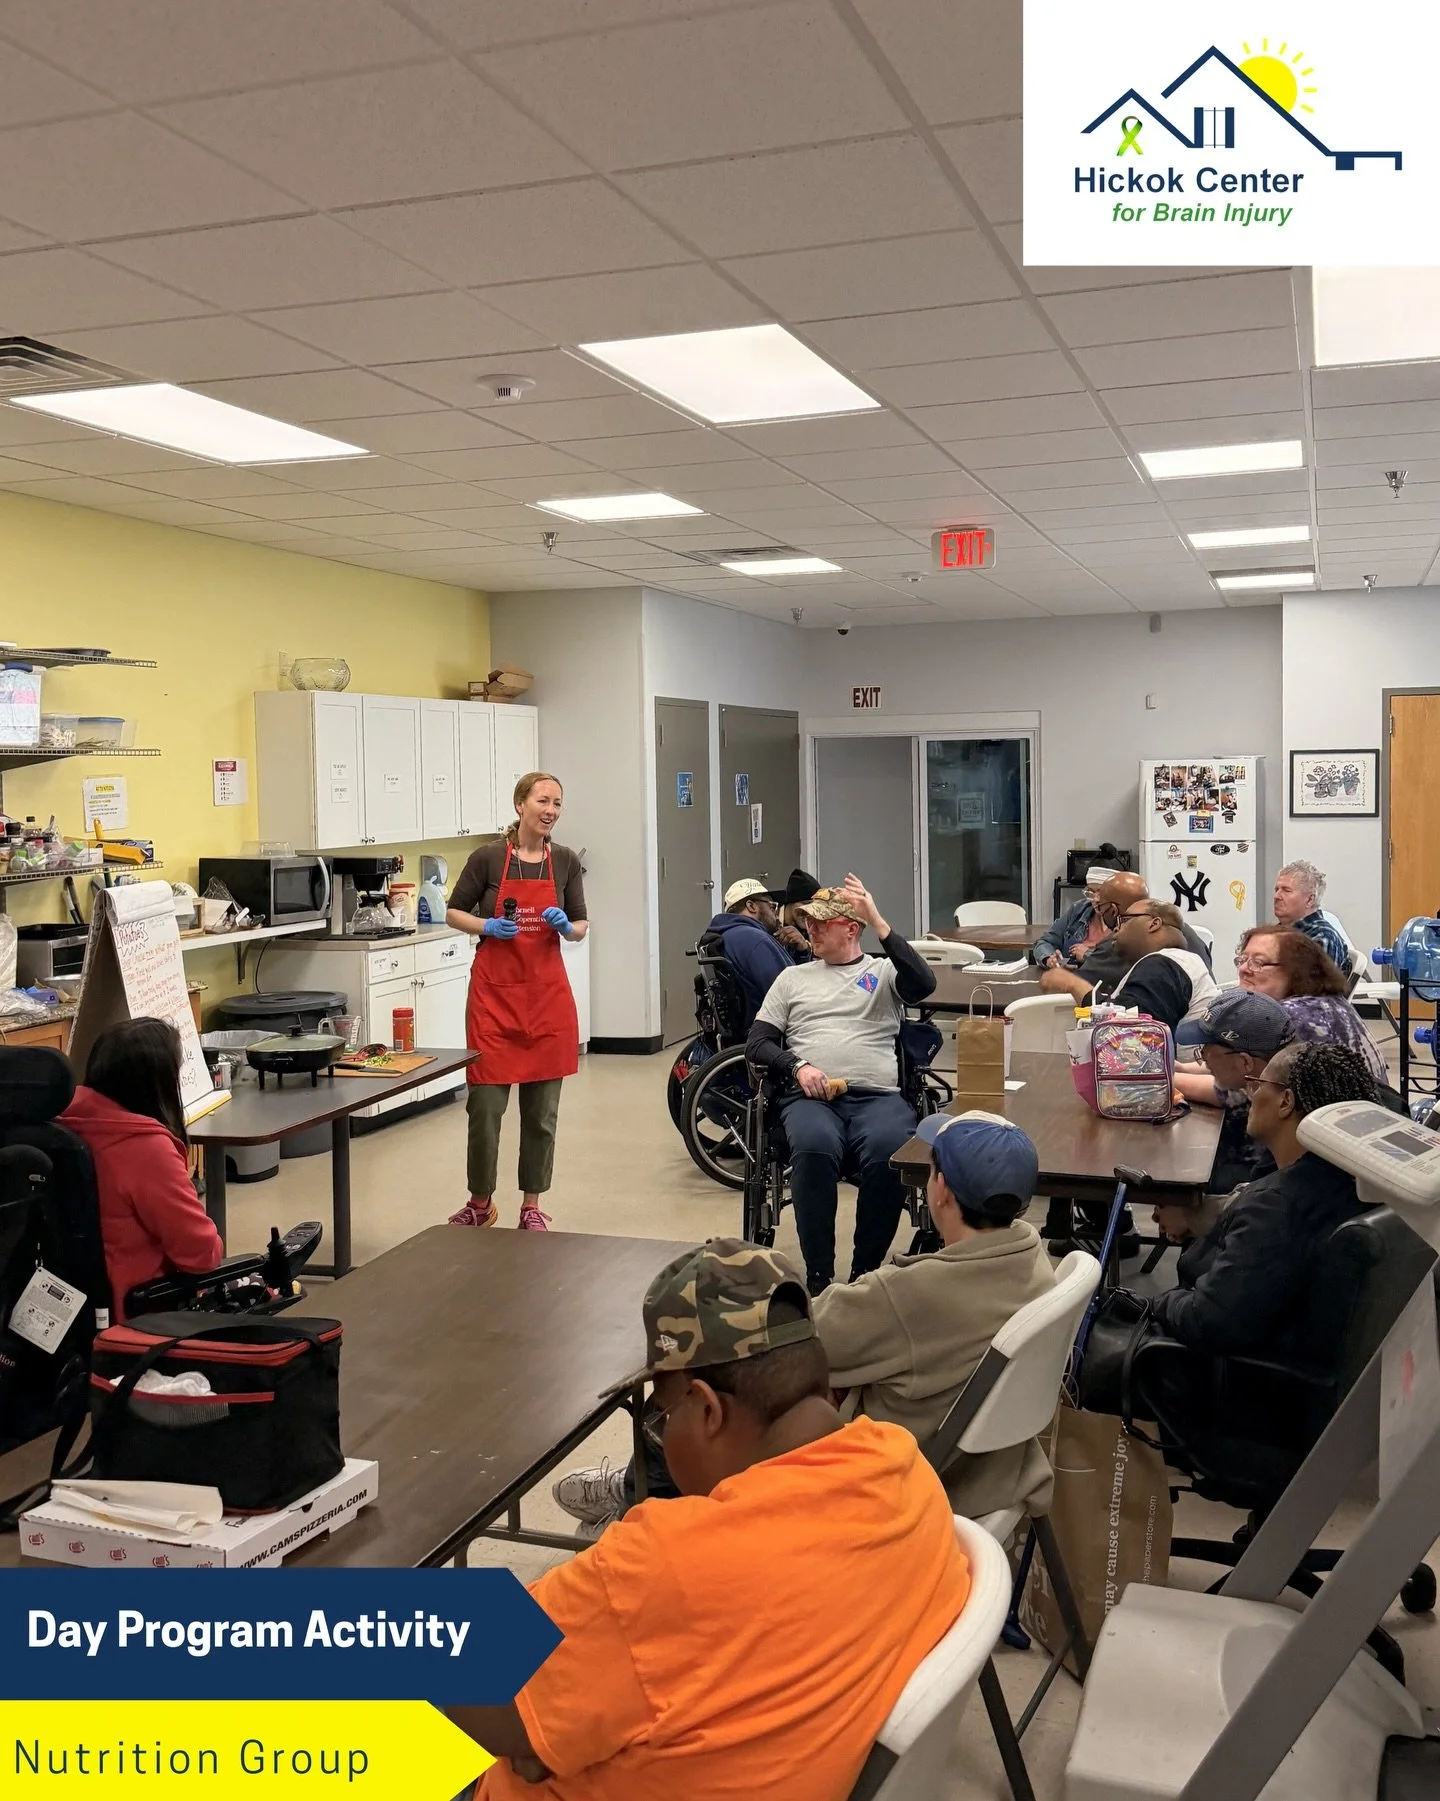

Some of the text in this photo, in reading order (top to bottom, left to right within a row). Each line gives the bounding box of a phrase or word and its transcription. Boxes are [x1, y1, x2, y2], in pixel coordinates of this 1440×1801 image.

[941, 530, 987, 568] EXIT
[853, 686, 881, 708] EXIT
[1105, 1433, 1130, 1615] may cause extreme joy
